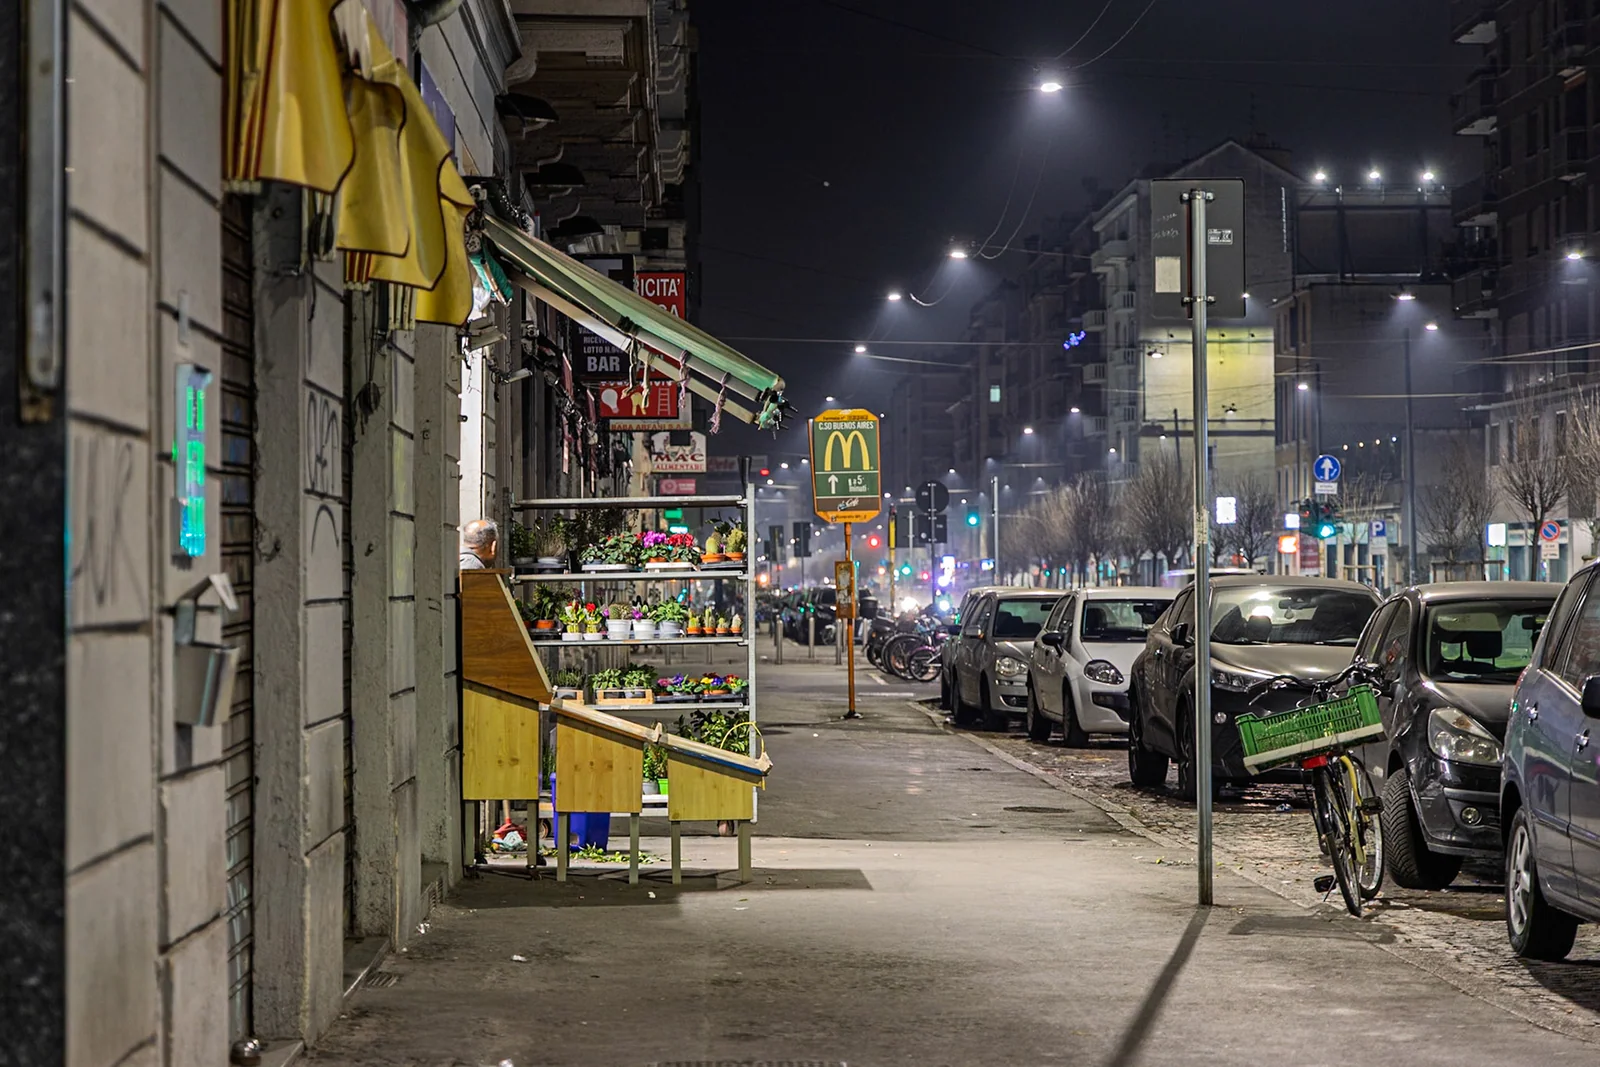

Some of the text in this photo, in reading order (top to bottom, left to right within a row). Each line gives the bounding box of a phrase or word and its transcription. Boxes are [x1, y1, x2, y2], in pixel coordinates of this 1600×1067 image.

[583, 346, 604, 354] LOTTO
[587, 356, 620, 372] BAR
[856, 421, 874, 429] AIRES
[654, 453, 704, 462] MAC
[1372, 521, 1383, 536] P
